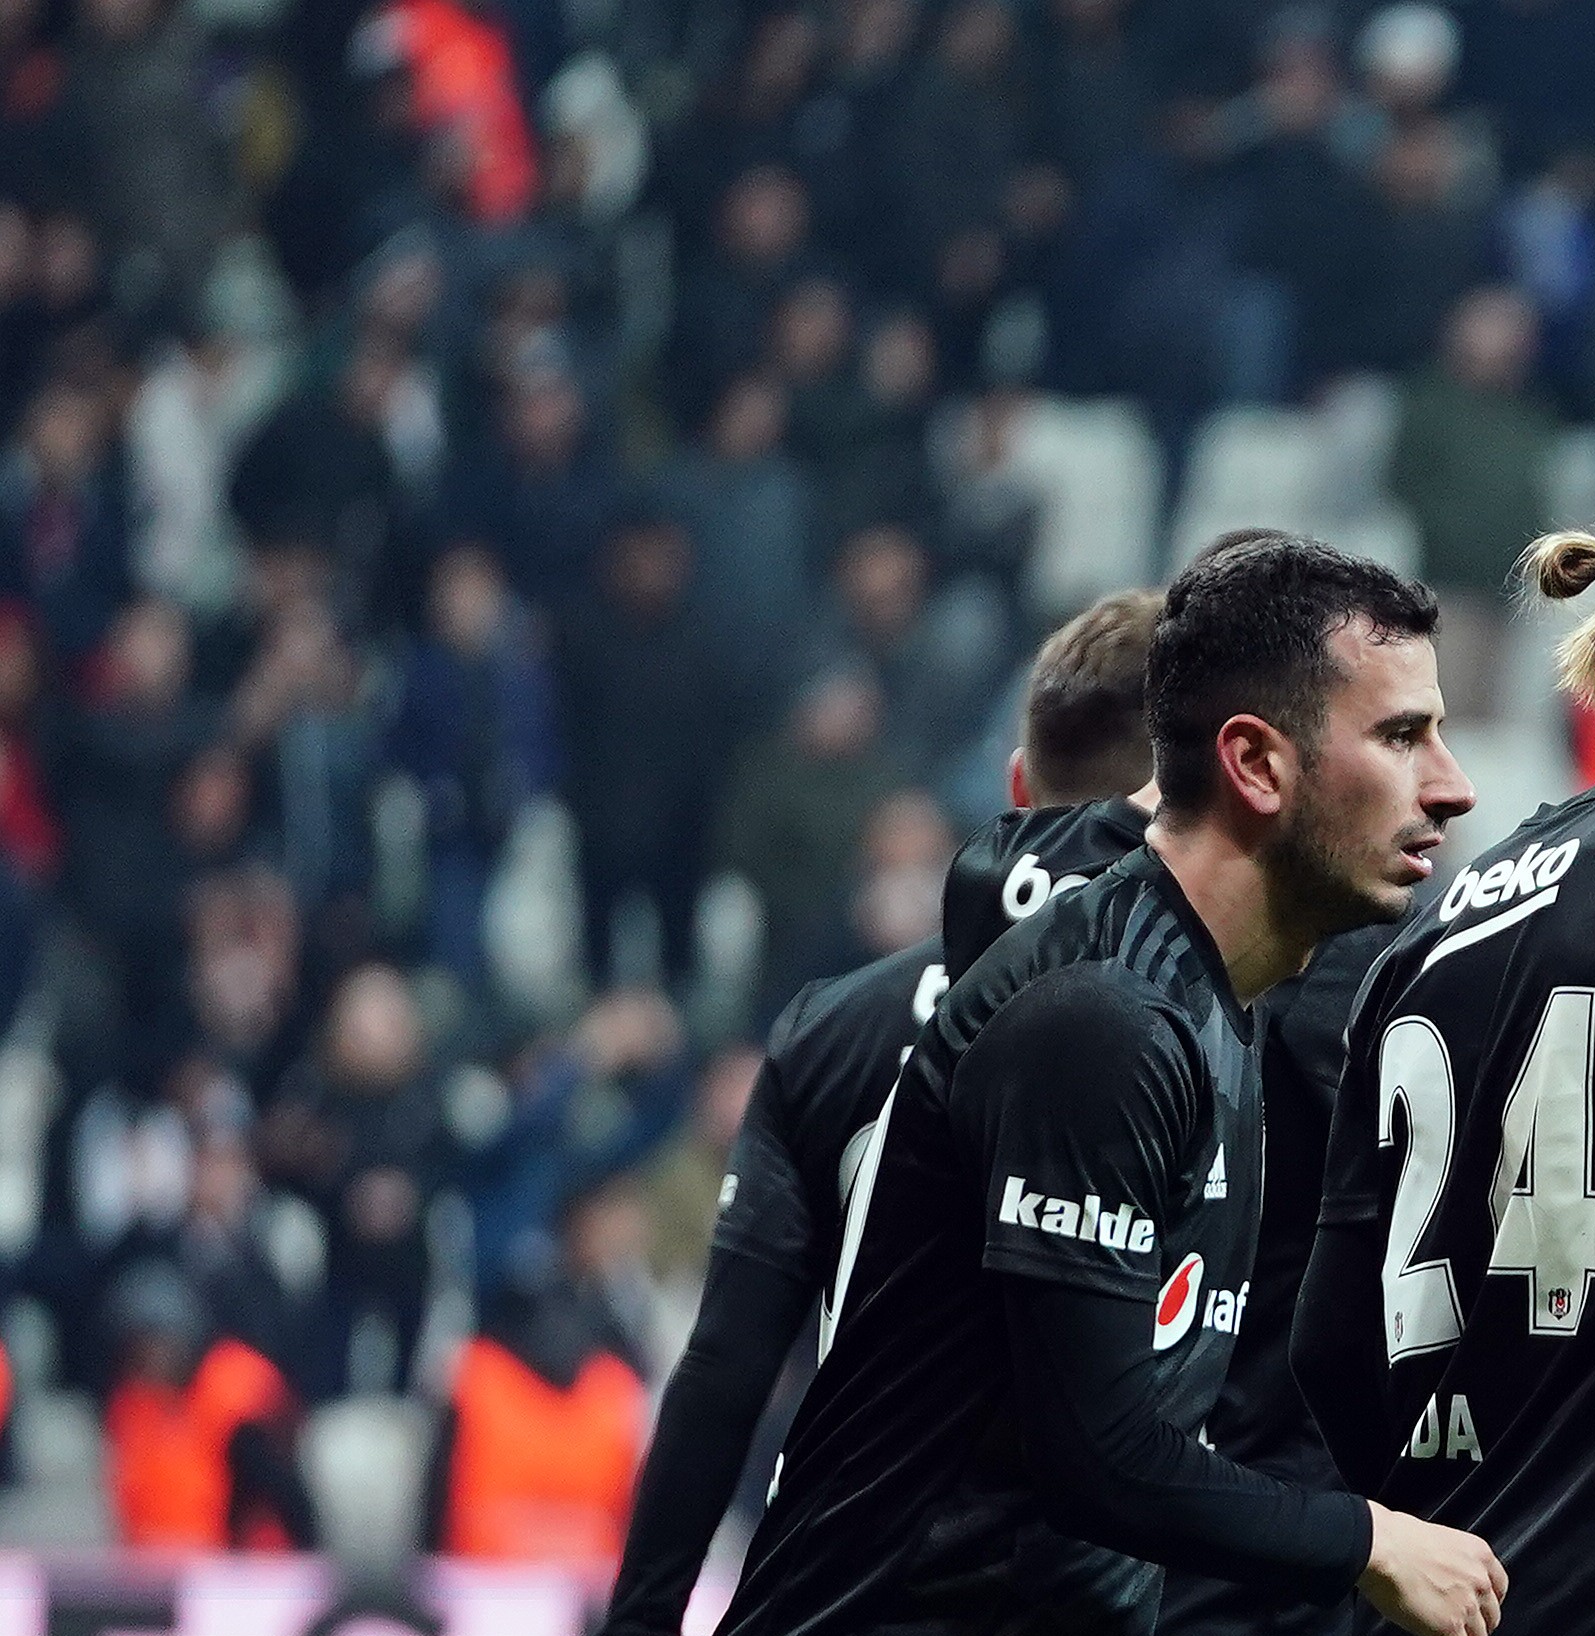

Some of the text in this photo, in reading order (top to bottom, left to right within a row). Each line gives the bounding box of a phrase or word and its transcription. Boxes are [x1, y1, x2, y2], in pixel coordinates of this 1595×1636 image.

[1439, 838, 1580, 924] beko
[999, 1175, 1155, 1254] kalde
[1400, 1392, 1483, 1462] DA
